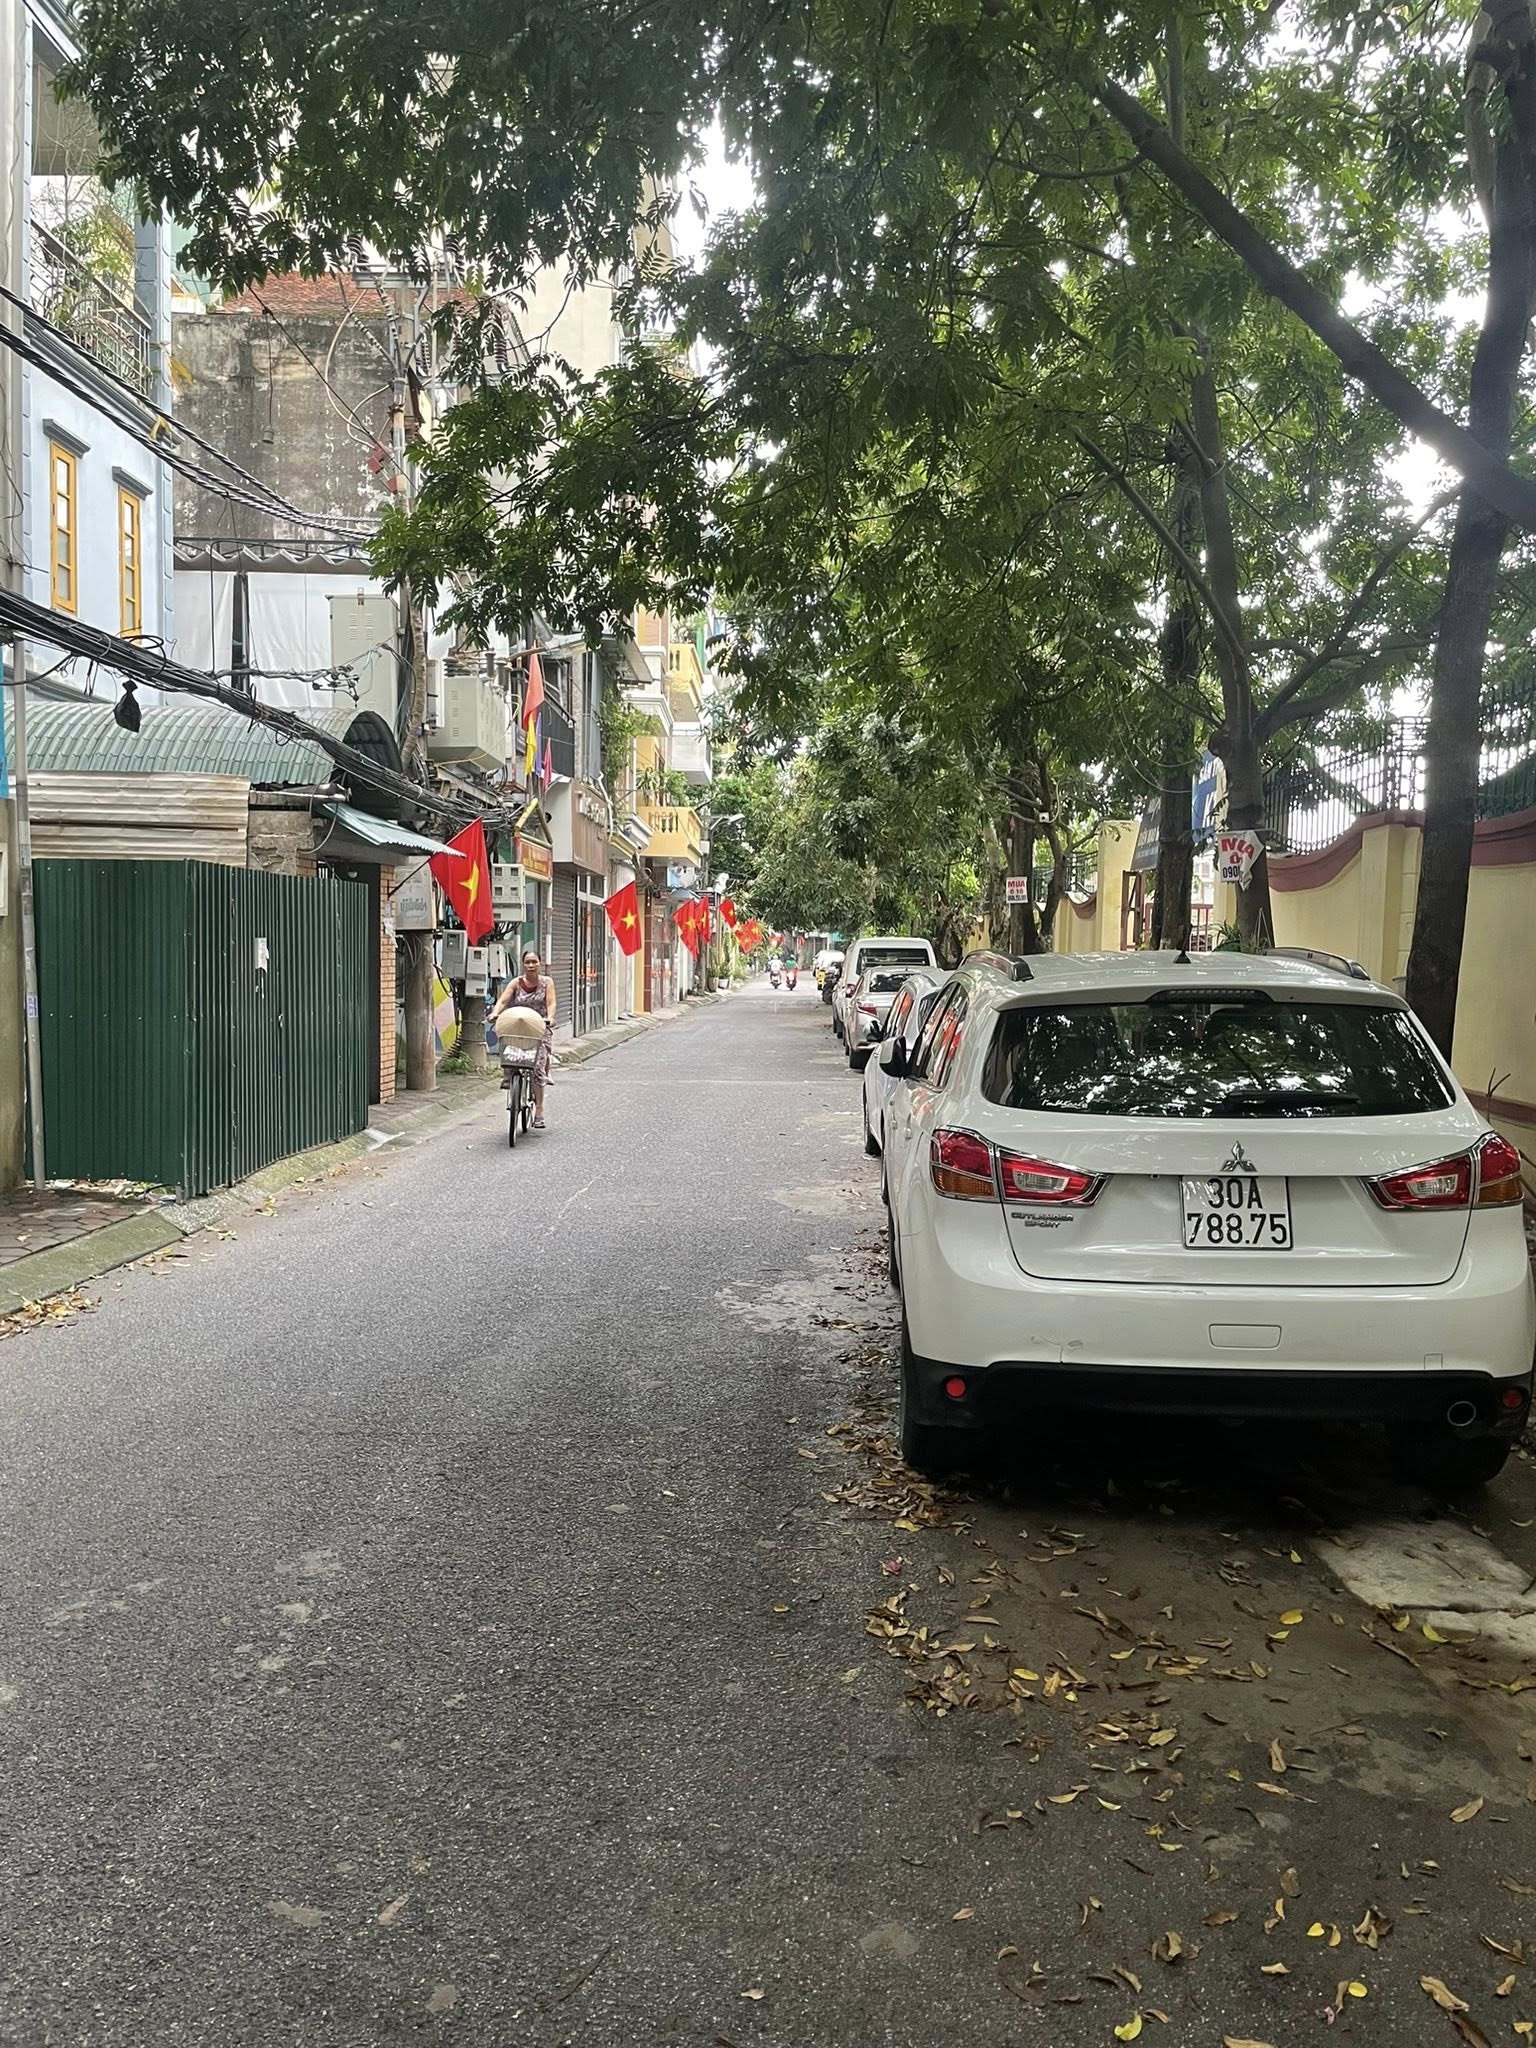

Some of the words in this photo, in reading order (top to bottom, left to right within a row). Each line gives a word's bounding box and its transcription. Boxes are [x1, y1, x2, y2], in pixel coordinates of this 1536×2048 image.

[1222, 865, 1240, 879] 090
[1207, 1178, 1263, 1209] 30A
[1186, 1213, 1287, 1244] 788.75
